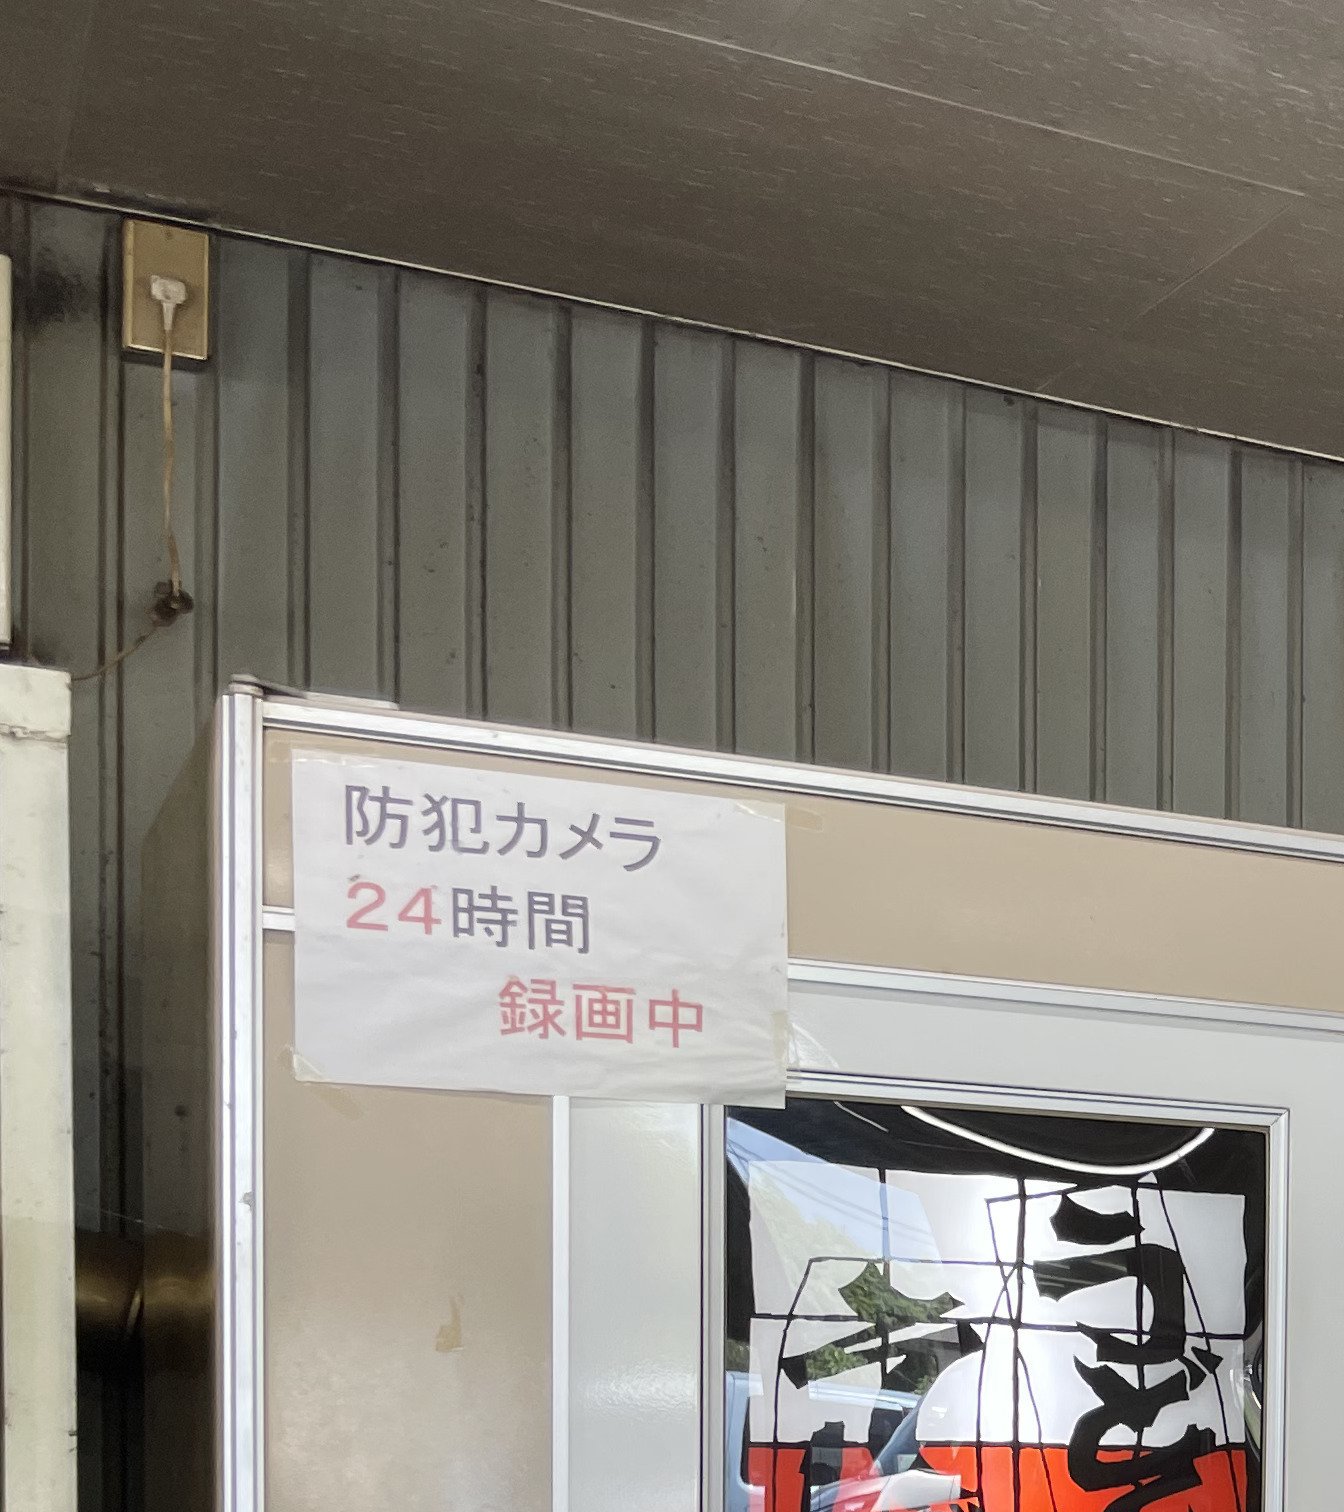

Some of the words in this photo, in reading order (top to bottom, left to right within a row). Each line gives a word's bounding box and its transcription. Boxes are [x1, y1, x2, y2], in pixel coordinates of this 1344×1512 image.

[345, 784, 661, 872] 防犯カメラ
[346, 881, 590, 954] 24時間
[499, 977, 703, 1048] 録画中
